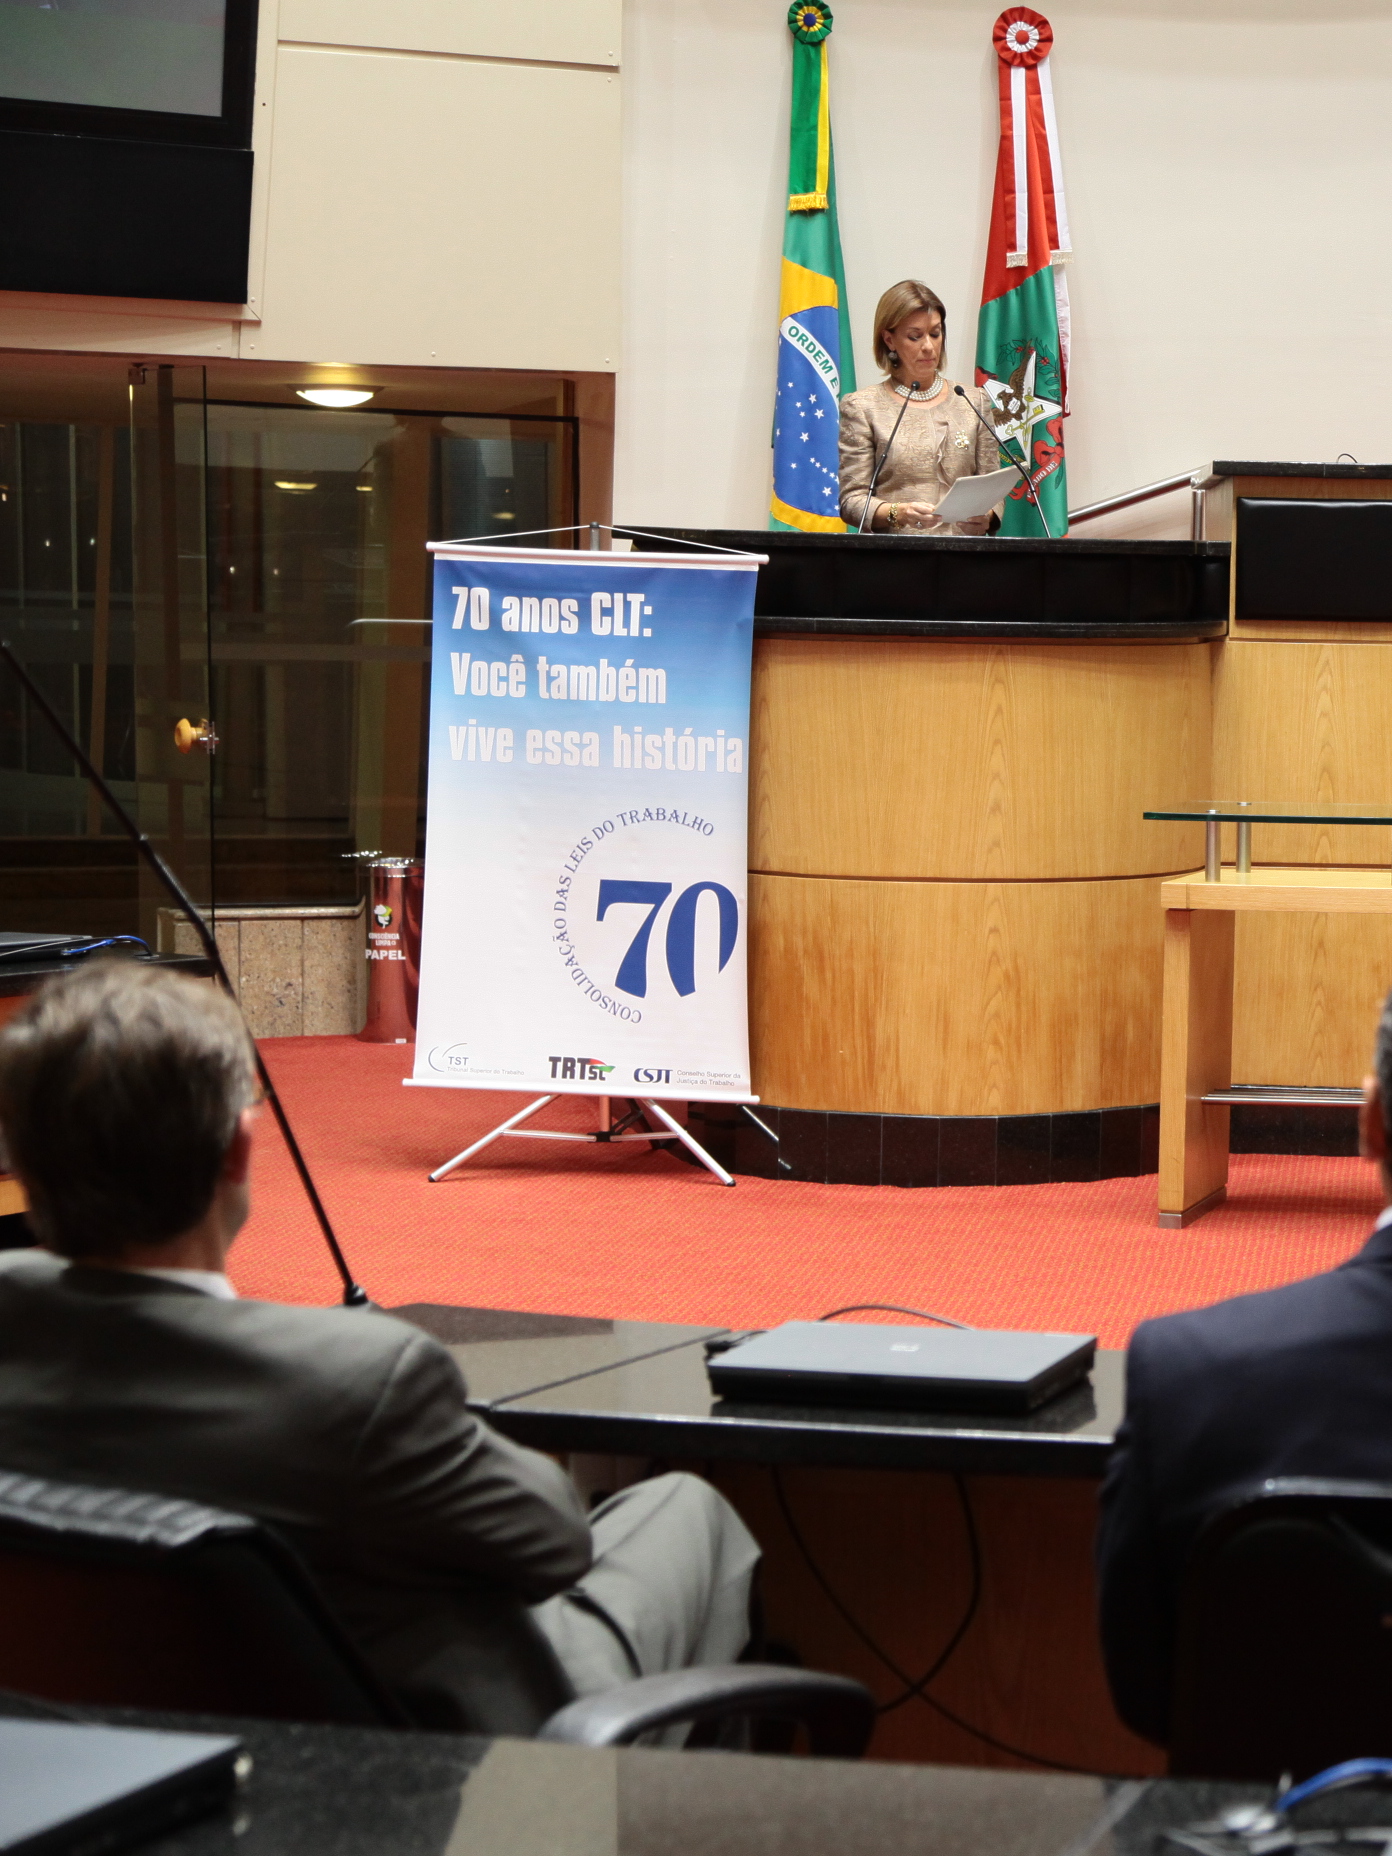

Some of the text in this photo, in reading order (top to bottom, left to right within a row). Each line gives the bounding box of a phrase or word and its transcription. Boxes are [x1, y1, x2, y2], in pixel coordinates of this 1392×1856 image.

[788, 325, 834, 375] ORDEM
[451, 586, 653, 638] 70 anos CLT:
[450, 652, 667, 704] Você também
[448, 718, 743, 774] vive essa história
[552, 807, 715, 1024] CONSOLIDAÇÃO DAS LEIS DO TRABALHO
[365, 949, 406, 960] PAPEL
[595, 878, 739, 999] 70
[448, 1056, 469, 1066] TST
[469, 1067, 493, 1075] Superior
[633, 1067, 674, 1084] CSJT
[676, 1069, 705, 1077] Conselho
[706, 1071, 731, 1079] Superior
[676, 1078, 696, 1086] Justiça
[708, 1079, 735, 1087] Trabalho
